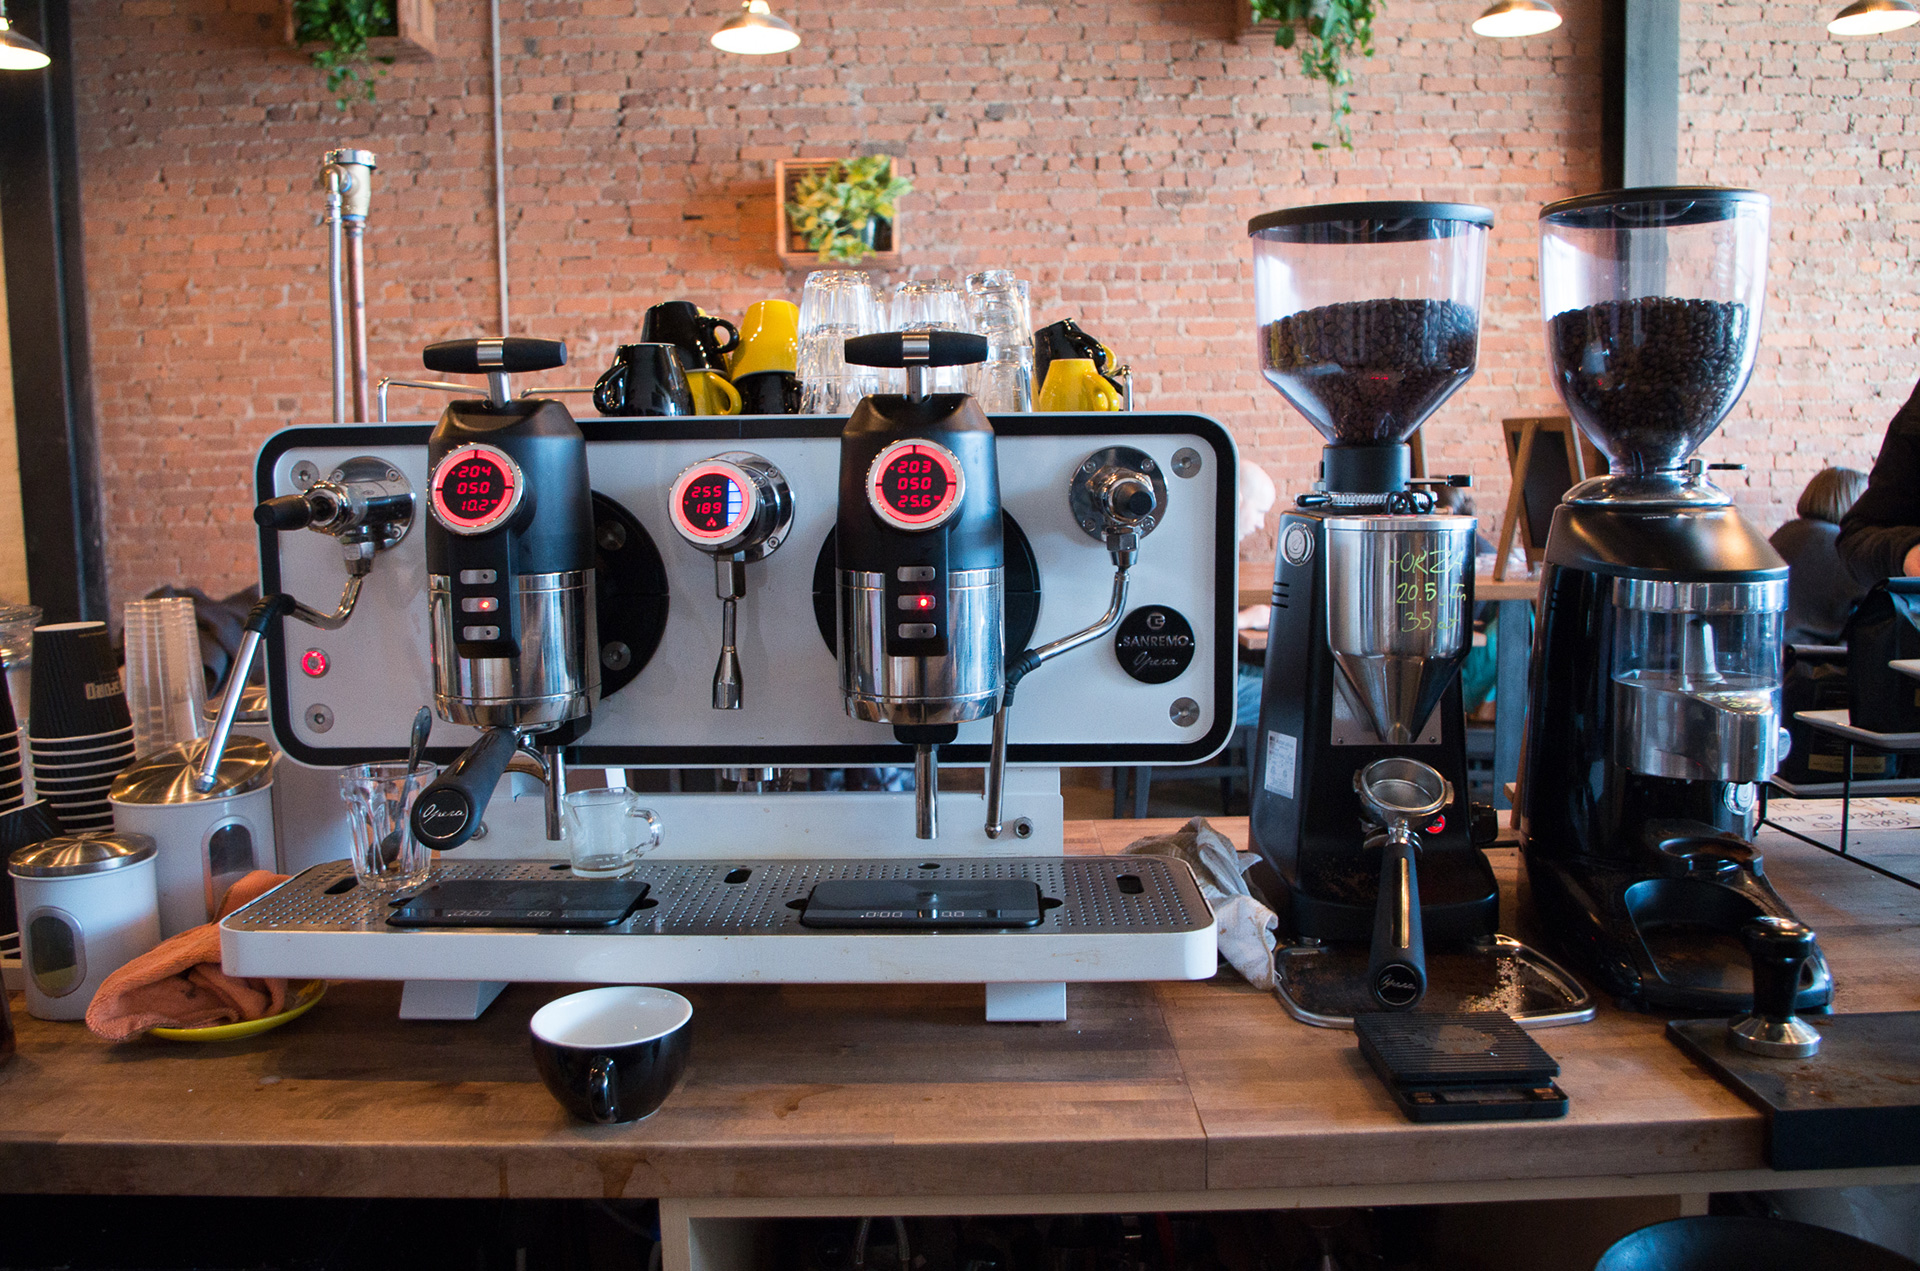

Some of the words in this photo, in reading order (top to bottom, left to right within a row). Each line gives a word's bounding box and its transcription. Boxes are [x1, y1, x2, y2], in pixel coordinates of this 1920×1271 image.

[458, 465, 492, 478] 204
[897, 460, 932, 474] 203
[457, 481, 491, 495] 050
[897, 477, 932, 490] 050
[691, 485, 722, 498] 255
[696, 502, 722, 514] 189
[1396, 582, 1437, 604] 20.5
[1401, 611, 1432, 632] 35
[1122, 635, 1190, 647] SANREMO
[422, 803, 465, 825] Opera
